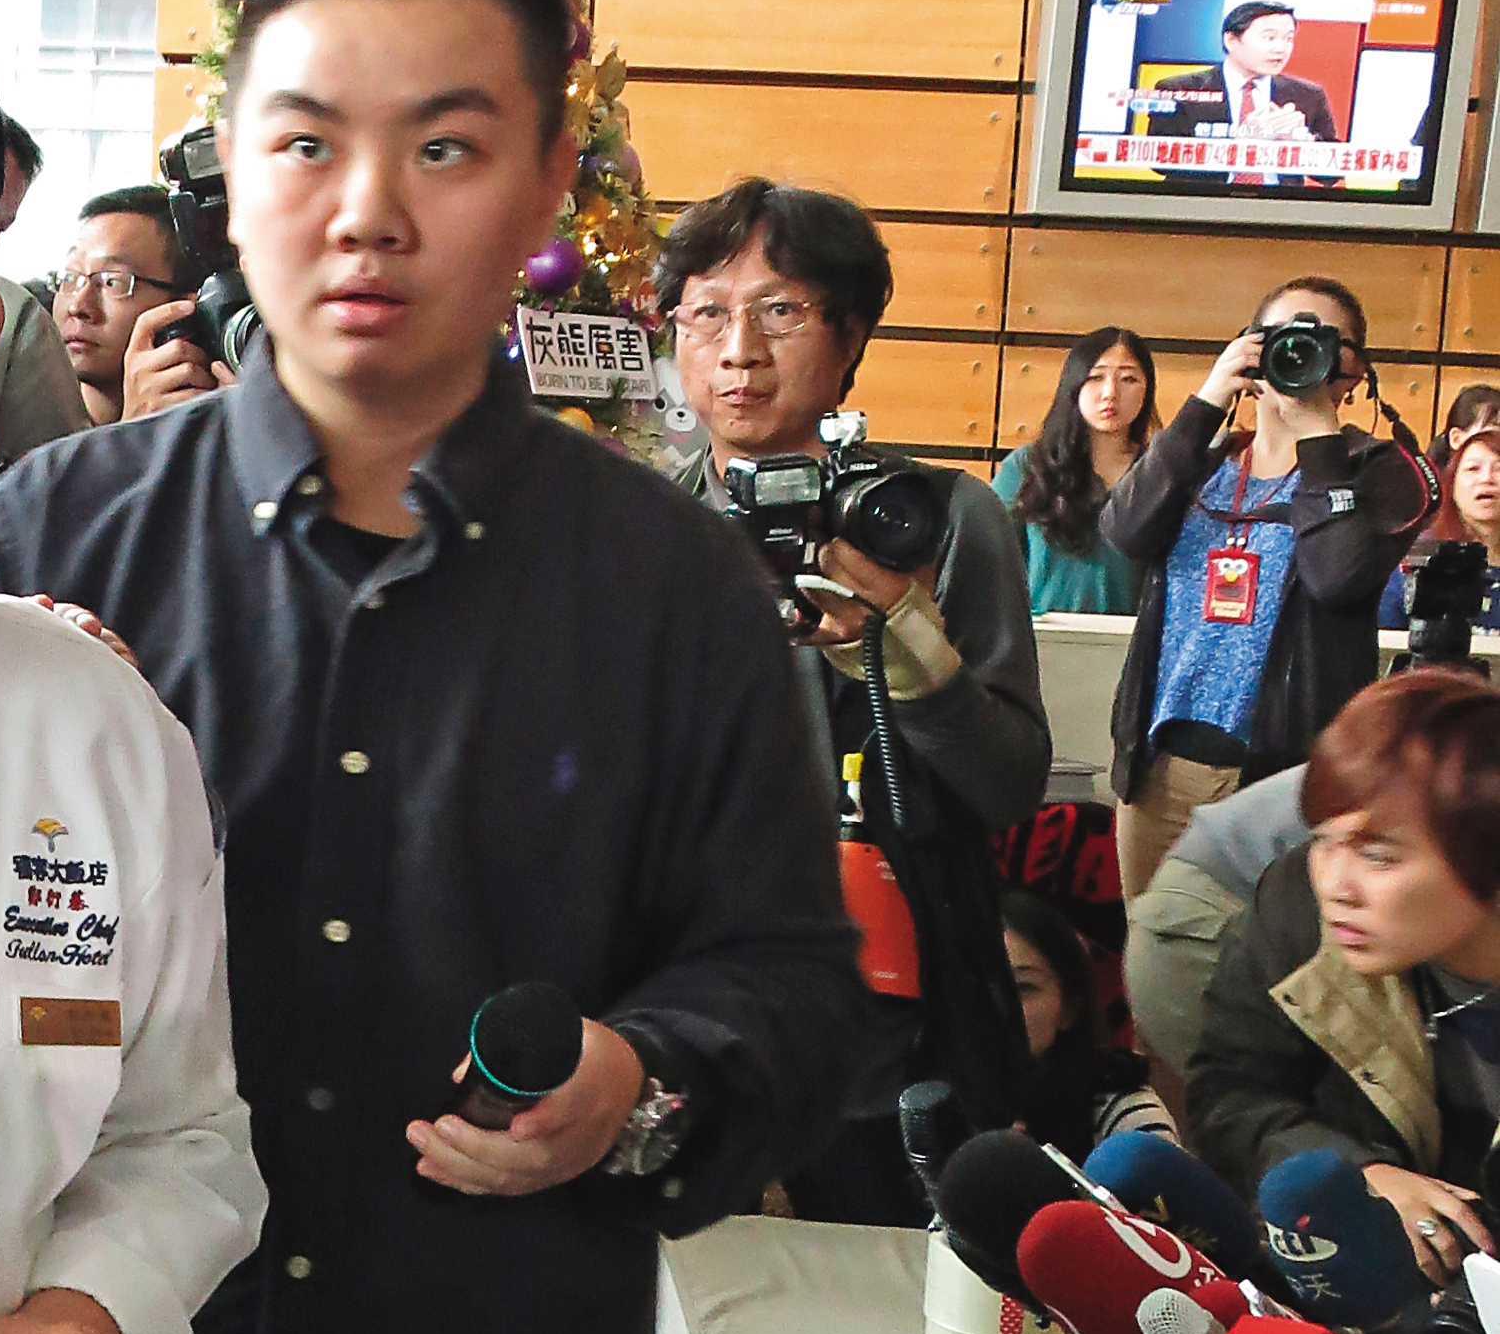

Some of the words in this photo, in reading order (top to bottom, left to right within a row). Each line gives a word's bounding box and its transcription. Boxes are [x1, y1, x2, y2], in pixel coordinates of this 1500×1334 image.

[526, 317, 645, 371] 灰熊厲害
[568, 374, 587, 390] TO
[588, 376, 604, 391] BE
[76, 913, 120, 945] Chef
